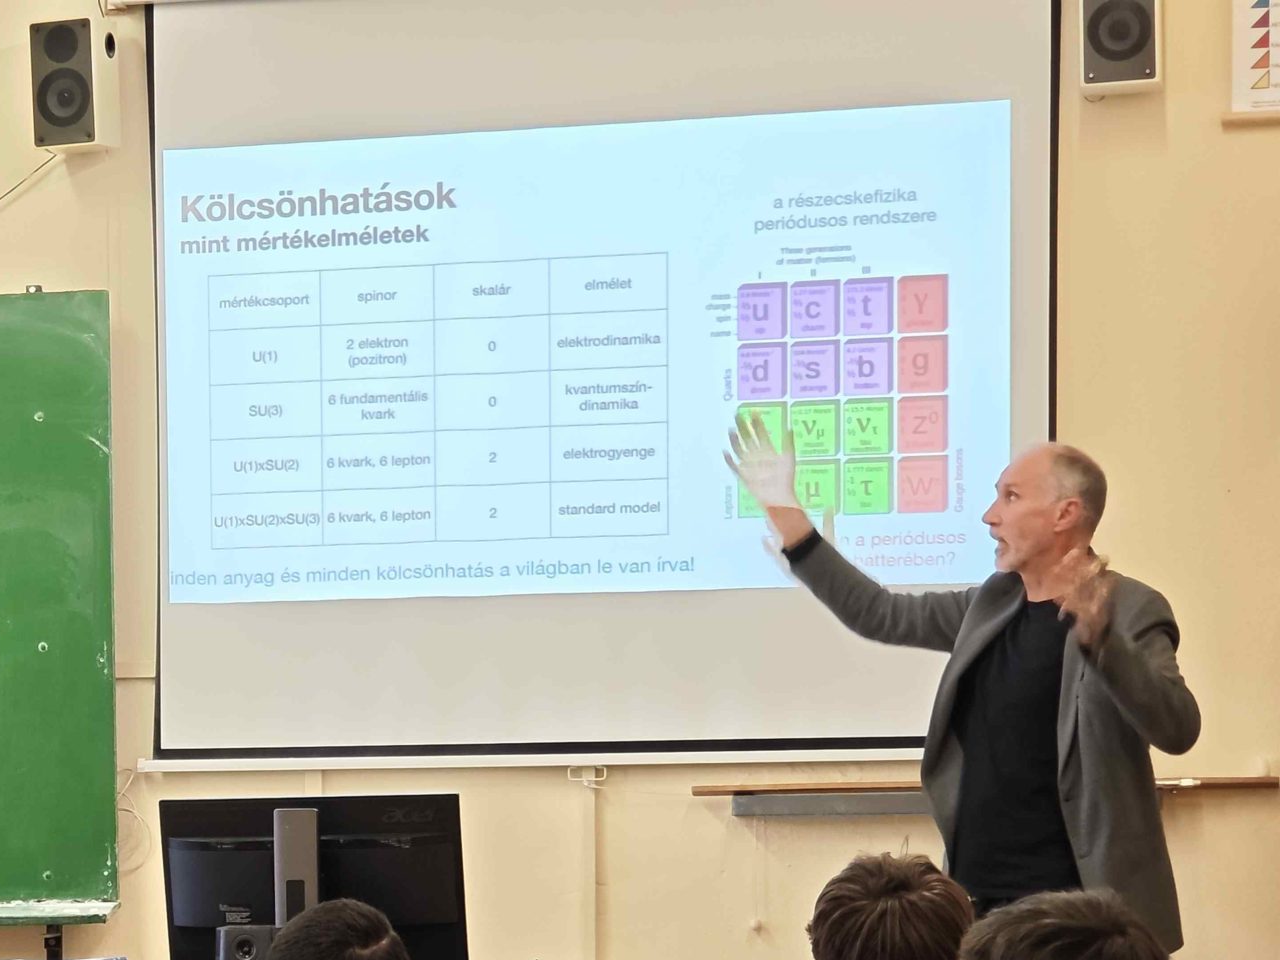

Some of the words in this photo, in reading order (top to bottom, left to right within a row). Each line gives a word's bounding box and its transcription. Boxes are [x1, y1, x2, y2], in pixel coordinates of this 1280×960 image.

[180, 181, 457, 223] Kölcsönhatások
[773, 198, 783, 209] a
[789, 188, 917, 208] részecskefizika
[754, 213, 848, 234] periódusos
[853, 209, 937, 226] rendszere
[180, 236, 229, 254] mint
[237, 225, 429, 252] mértékelméletek
[472, 283, 511, 296] skalár
[584, 277, 632, 291] elmélet
[219, 294, 309, 309] mértékcsoport
[357, 289, 397, 304] spinor
[752, 303, 769, 321] u
[804, 301, 820, 319] c
[862, 295, 872, 316] t
[346, 339, 354, 350] 2
[358, 336, 408, 349] elektron
[557, 333, 661, 348] elektrodinamika
[252, 350, 278, 364] U(1)
[348, 353, 407, 368] (pozitron)
[912, 353, 929, 376] g
[752, 359, 769, 382] d
[805, 361, 820, 379] s
[858, 355, 875, 378] b
[565, 380, 653, 395] kvantumszín-
[328, 394, 336, 405] 6
[340, 390, 428, 405] fundamentális
[579, 398, 639, 411] dinamika
[248, 404, 283, 418] SU(3)
[361, 408, 395, 420] kvark
[488, 452, 497, 463] 2
[563, 446, 655, 461] elektrogyenge
[233, 458, 299, 474] U(1)xSU(2)
[326, 457, 335, 468] 6
[338, 455, 376, 469] kvark,
[379, 455, 388, 467] 6
[391, 454, 431, 469] lepton
[954, 482, 966, 513] Gauge
[327, 512, 335, 523] 6
[338, 510, 376, 524] kvark,
[380, 510, 388, 521] 6
[392, 508, 431, 524] lepton
[489, 508, 497, 519] 2
[558, 502, 616, 516] standard
[620, 501, 660, 514] model
[214, 513, 320, 528] U(1)xSU(2)xSU(3)
[855, 535, 865, 546] a
[871, 529, 966, 549] periódusos
[223, 571, 274, 588] anyag
[280, 567, 300, 583] és
[306, 566, 370, 583] minden
[376, 561, 494, 581] kölcsönhatás
[500, 564, 510, 577] a
[517, 559, 591, 578] világban
[597, 559, 613, 574] le
[618, 560, 651, 574] van
[657, 556, 695, 572] írva!
